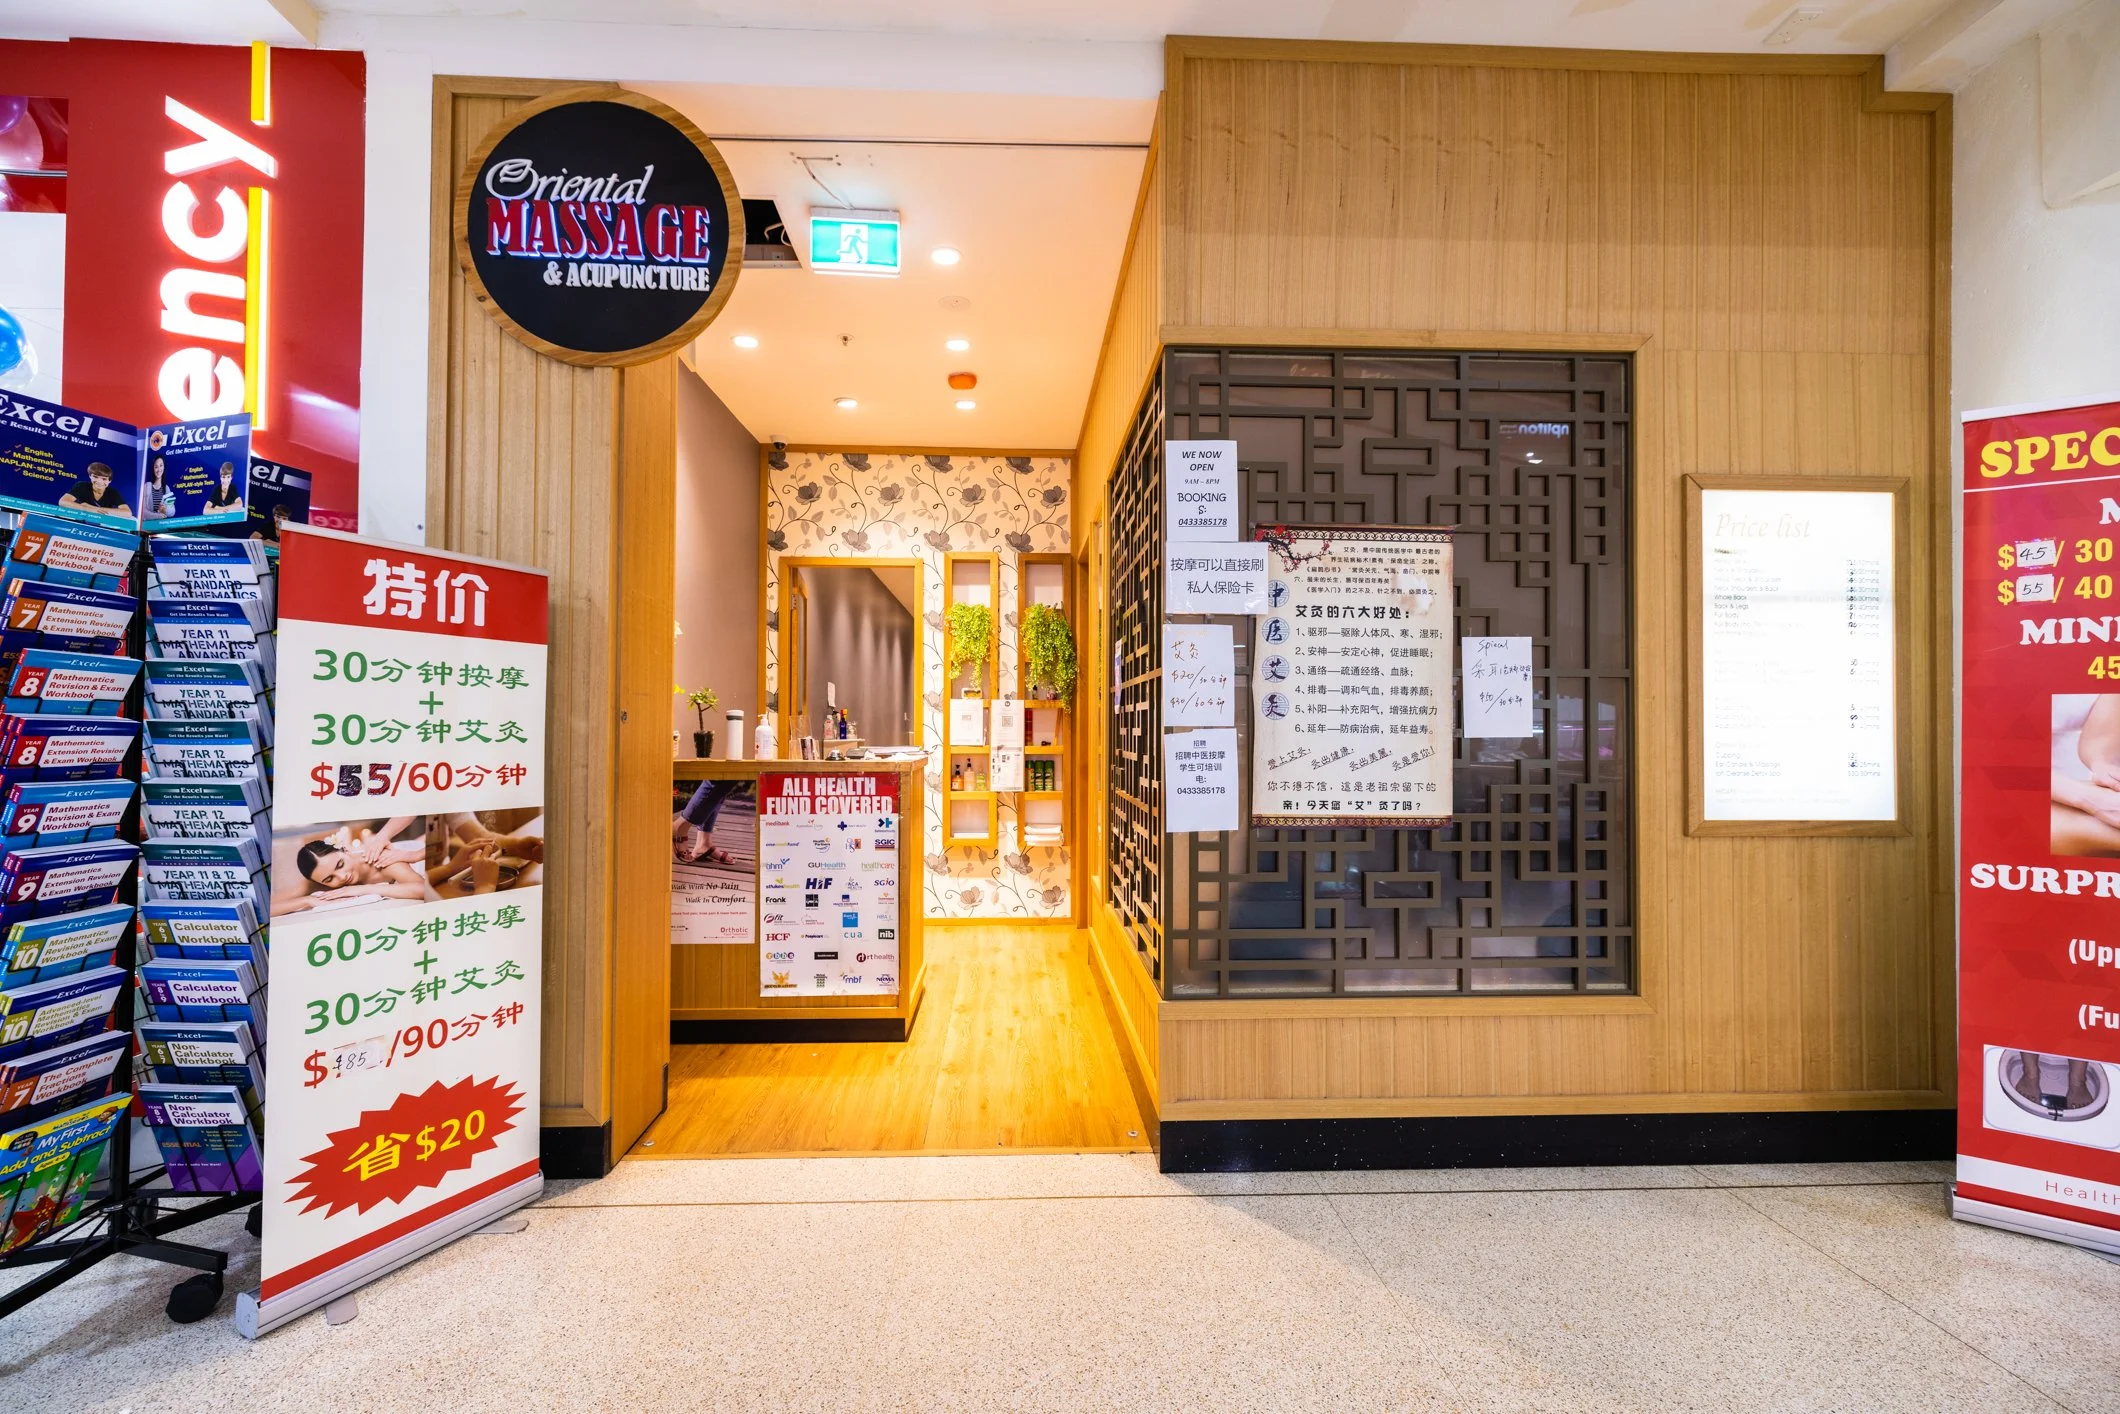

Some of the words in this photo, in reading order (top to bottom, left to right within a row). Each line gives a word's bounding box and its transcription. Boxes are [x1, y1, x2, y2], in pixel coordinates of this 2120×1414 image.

[485, 158, 654, 207] Oriental
[486, 198, 710, 264] MASSAGE
[158, 95, 279, 423] ency
[543, 262, 563, 287] &
[565, 265, 710, 292] ACUPUNCTURE
[10, 420, 47, 435] Results
[51, 431, 68, 440] You
[71, 436, 98, 448] Want!
[170, 420, 226, 446] Excel
[13, 452, 64, 468] Mathematics
[24, 447, 53, 458] English
[1980, 426, 2120, 479] SPEC
[23, 470, 54, 481] Science
[57, 470, 77, 479] Tests
[1177, 493, 1227, 502] BOOKING
[1198, 505, 1206, 514] S:
[1178, 518, 1227, 526] 0433385178
[1715, 513, 1769, 538] Price
[1777, 513, 1812, 538] list
[70, 527, 100, 539] Excel
[21, 542, 41, 561] 7
[52, 540, 114, 558] Mathematics
[2074, 538, 2113, 564] 30
[46, 558, 94, 571] Workbook
[49, 549, 90, 562] Revision
[99, 559, 124, 568] Exam
[1171, 558, 1264, 572] 按摩可以直接刷
[184, 569, 217, 578] YEAR
[220, 569, 230, 578] 11
[179, 580, 242, 590] STANDARD
[363, 558, 489, 627] 特价
[1187, 581, 1255, 594] 私人保险卡
[2074, 574, 2113, 600] 40
[49, 606, 104, 618] Mathematics
[45, 616, 87, 625] Extension
[90, 620, 123, 629] Revision
[50, 625, 73, 633] Exam
[75, 627, 116, 637] Workbook
[52, 673, 116, 683] Mathematics
[312, 649, 530, 690] 30分钟按摩
[49, 682, 90, 690] Revision
[180, 689, 211, 698] YEAR
[214, 690, 226, 698] 12
[311, 713, 529, 745] 30分钟艾灸
[1175, 752, 1225, 760] 招聘中医按摩
[1179, 763, 1222, 772] 学生可培训
[310, 762, 527, 800] $55/60分钟
[783, 777, 811, 796] ALL
[815, 777, 876, 795] HEALTH
[766, 797, 811, 815] FUND
[816, 796, 892, 814] COVERED
[720, 882, 739, 890] Pain
[1970, 862, 2120, 899] SURPR
[711, 894, 746, 906] Comfort
[174, 922, 238, 931] Calculator
[177, 935, 241, 944] Workbook
[305, 904, 527, 968] 60分钟按摩
[766, 933, 790, 941] HCF
[304, 959, 525, 1036] 30分钟艾灸
[43, 1072, 64, 1083] The
[66, 1055, 114, 1075] Complete
[40, 1071, 87, 1092] Fractions
[37, 1134, 60, 1150] My
[60, 1122, 90, 1141] First
[0, 1157, 28, 1175] Add
[30, 1146, 58, 1164] and
[58, 1125, 112, 1153] Subtract
